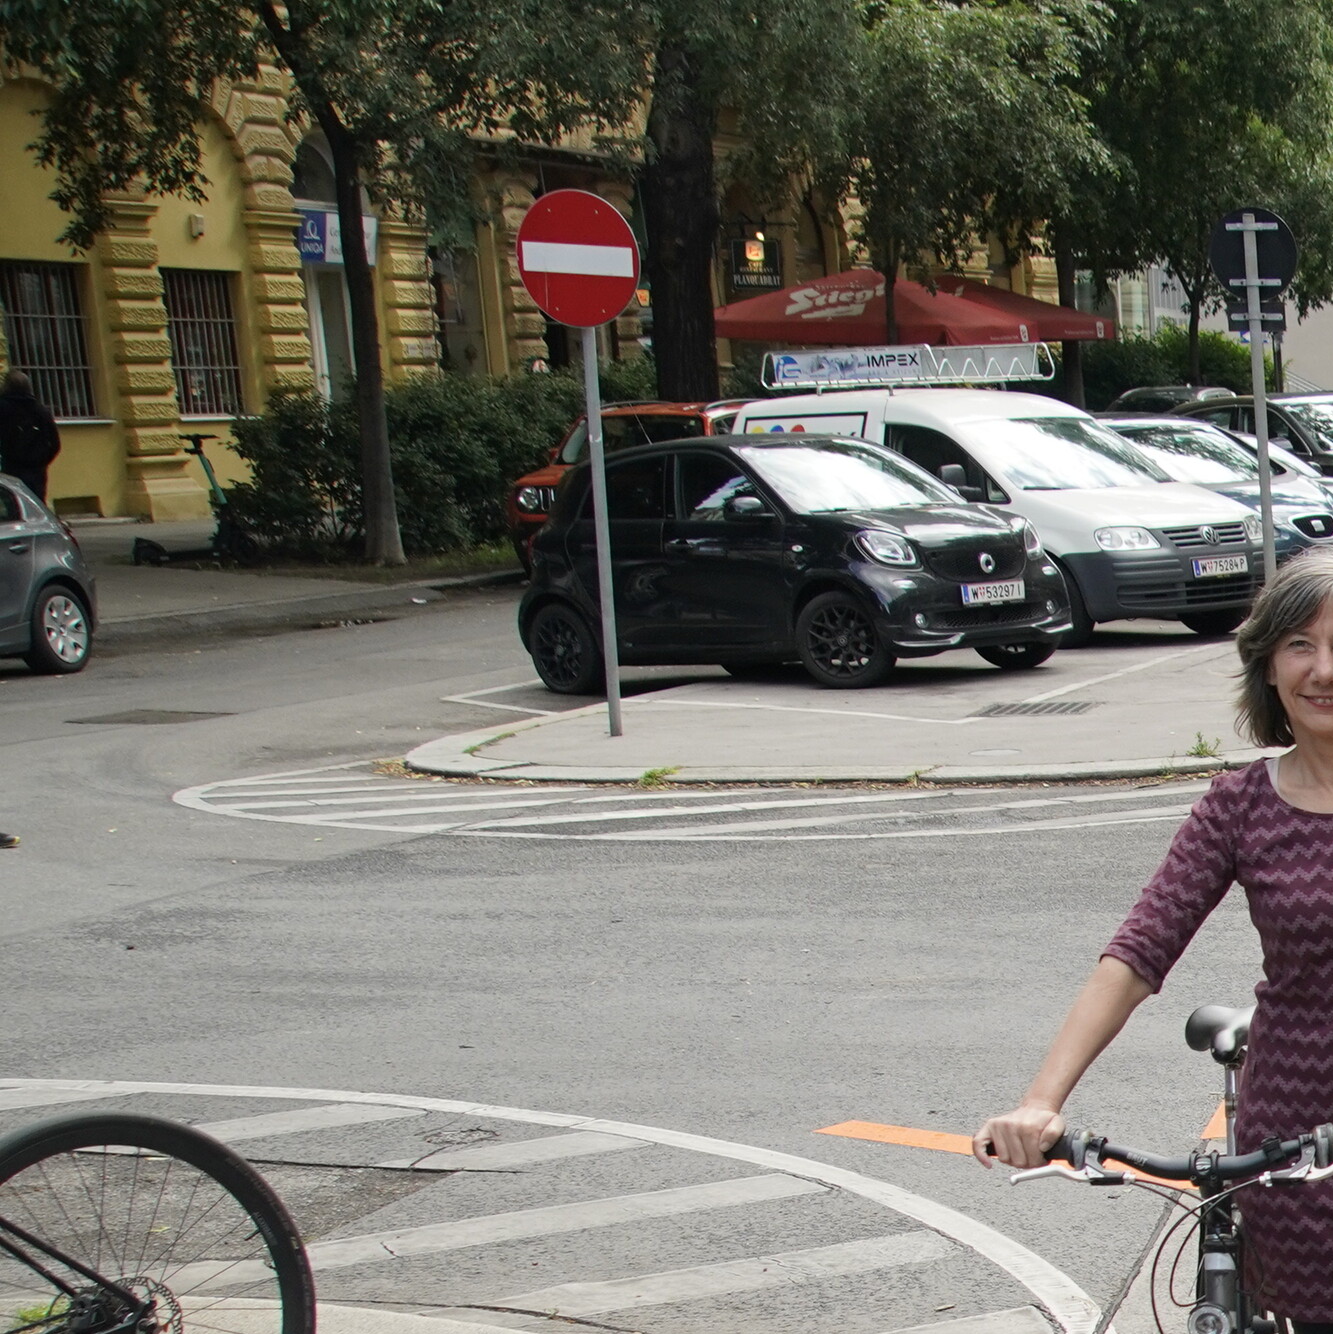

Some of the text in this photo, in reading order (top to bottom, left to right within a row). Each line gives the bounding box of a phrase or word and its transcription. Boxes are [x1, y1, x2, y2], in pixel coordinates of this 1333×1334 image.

[300, 242, 324, 254] UNIQA
[867, 353, 920, 368] IMPEX
[1200, 558, 1245, 573] W 75284 P
[971, 587, 979, 600] W
[986, 584, 1015, 599] 53297
